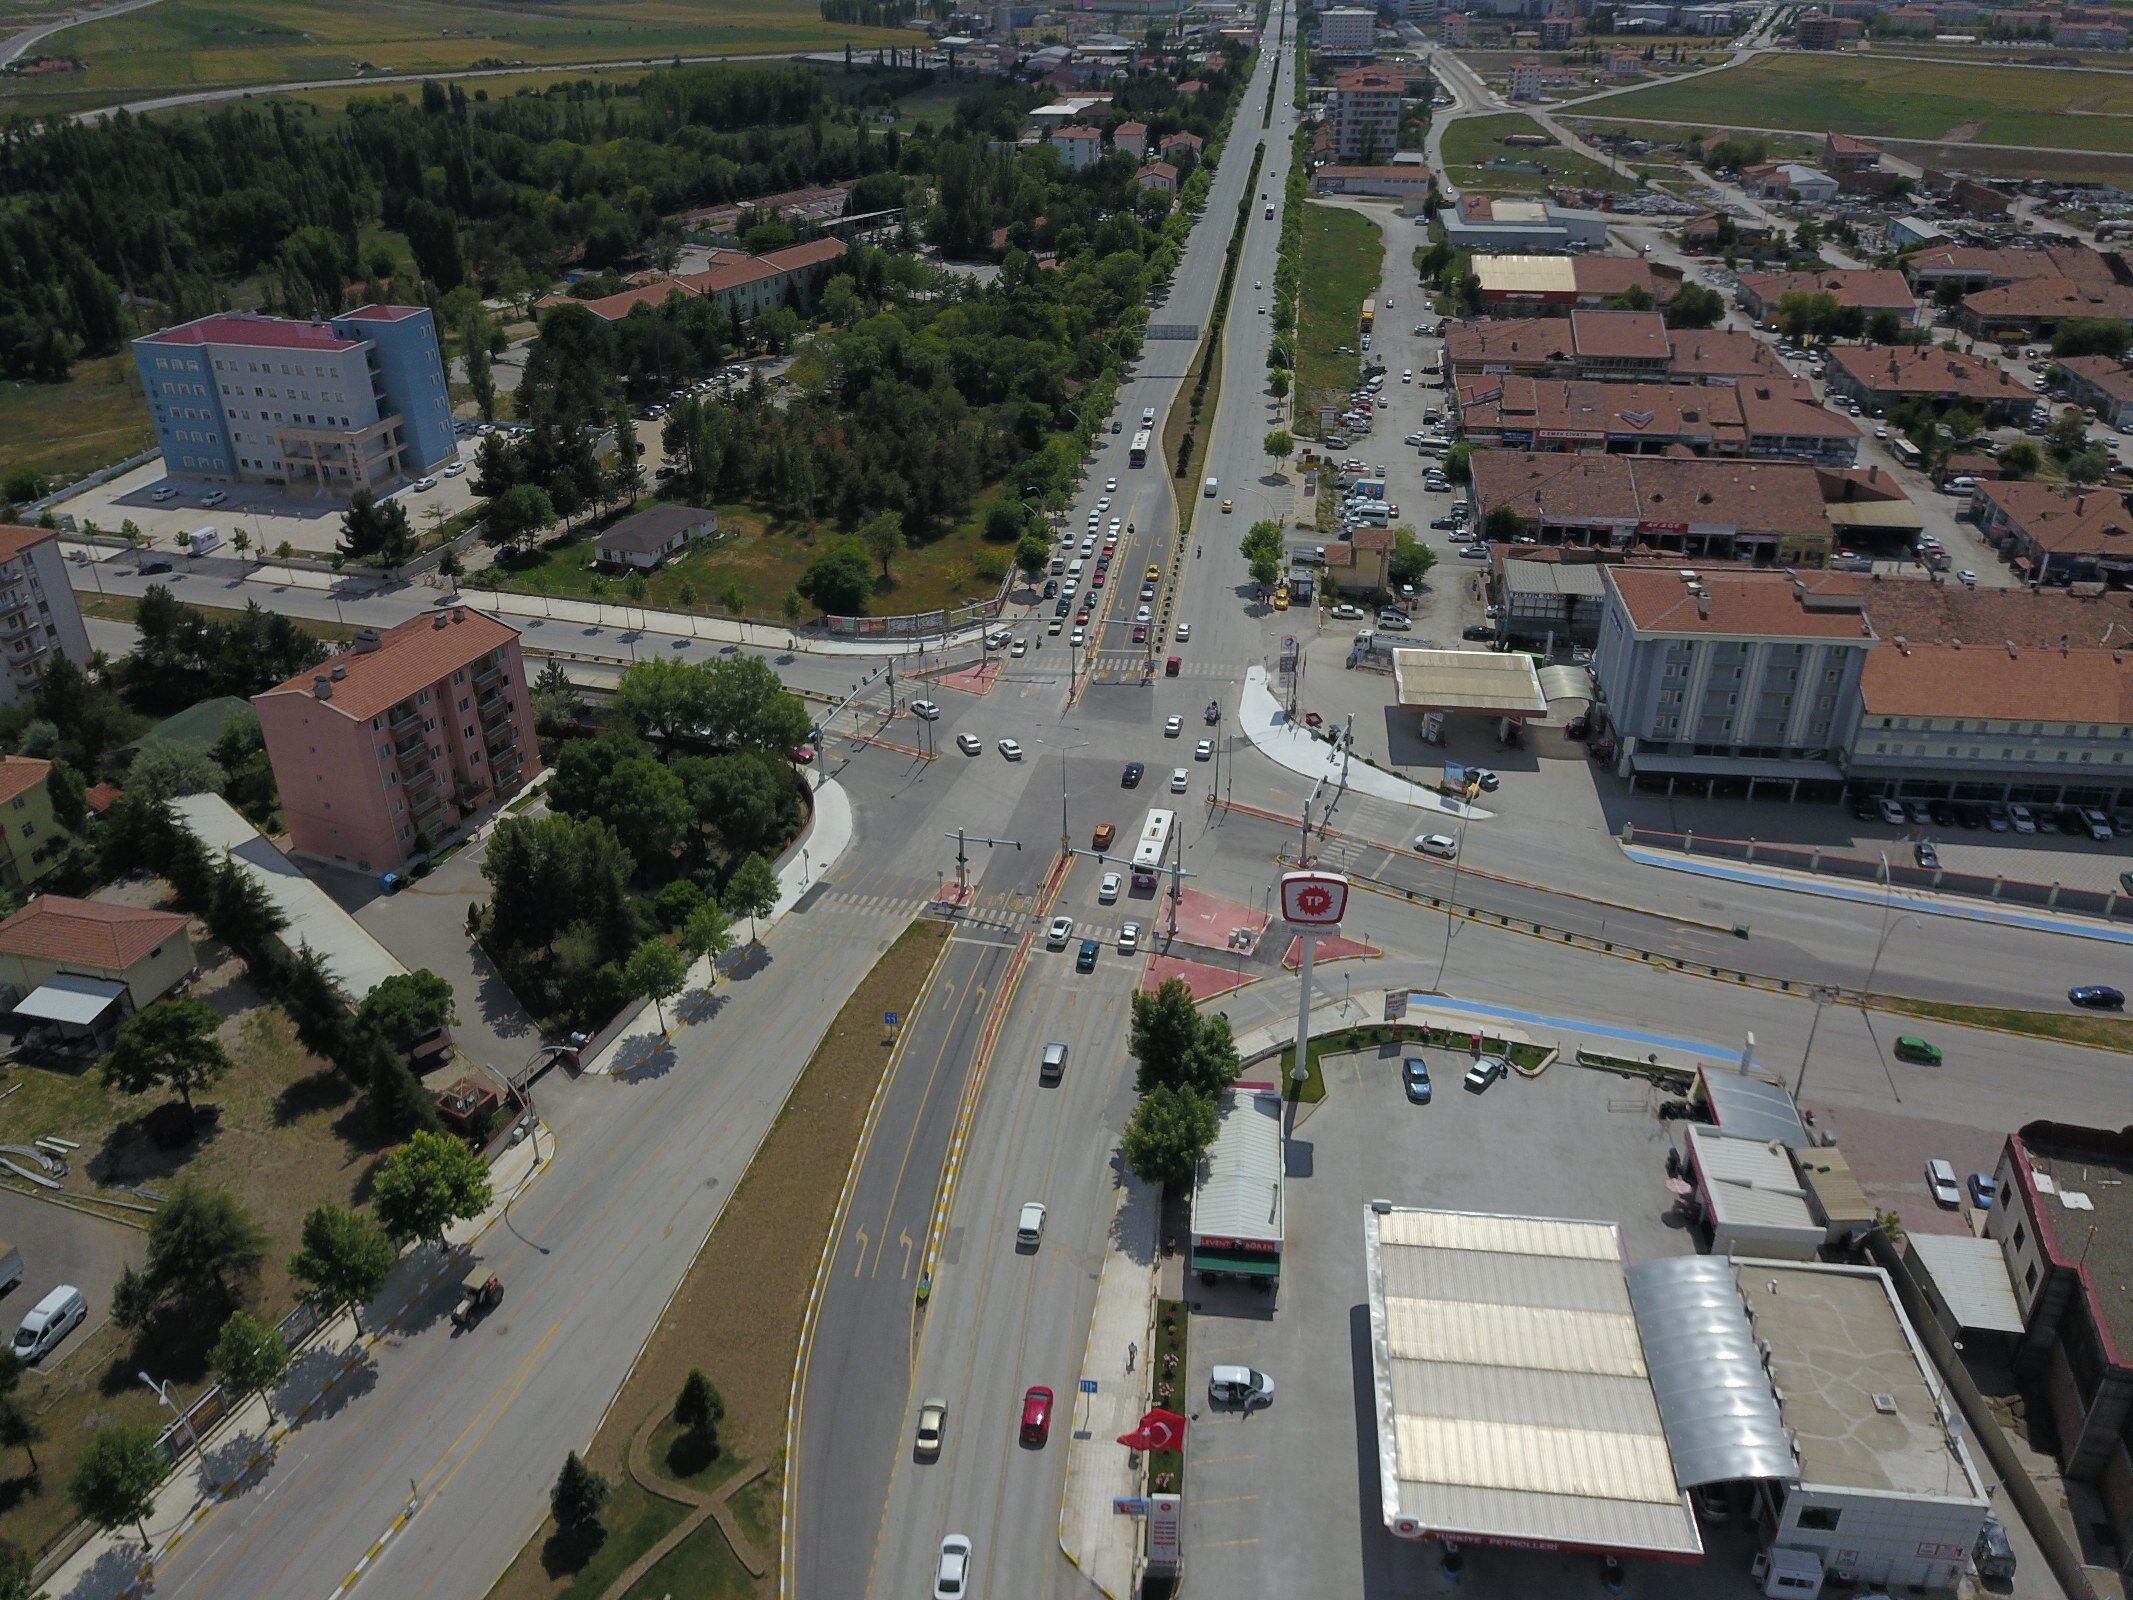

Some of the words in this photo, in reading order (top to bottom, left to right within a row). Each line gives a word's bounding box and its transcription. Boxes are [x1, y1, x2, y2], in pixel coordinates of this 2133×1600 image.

[1306, 896, 1324, 906] TP
[1435, 1532, 1482, 1545] TÜRKİYE
[1489, 1537, 1558, 1551] PETROLLERİ
